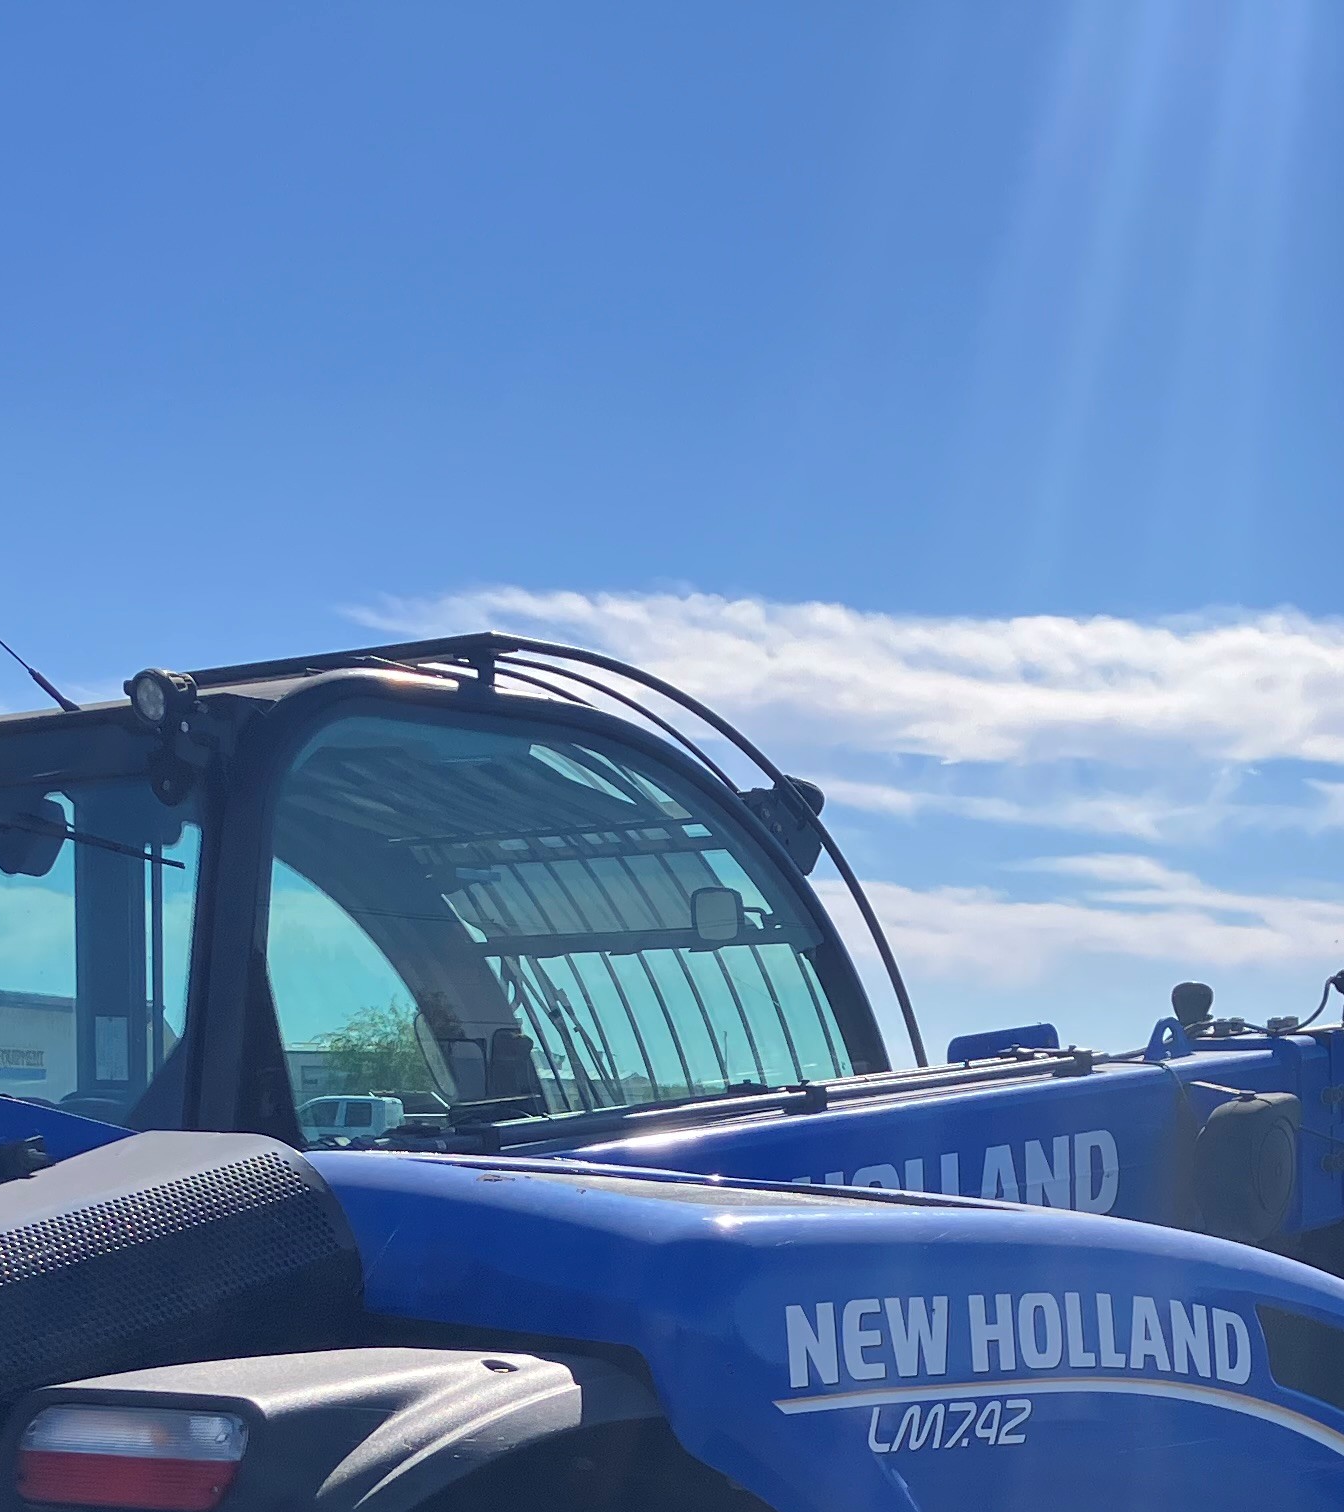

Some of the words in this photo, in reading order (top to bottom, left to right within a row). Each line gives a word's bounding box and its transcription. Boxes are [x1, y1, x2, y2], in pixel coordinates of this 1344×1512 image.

[791, 1129, 1119, 1214] LAND
[785, 1295, 949, 1388] NEW
[967, 1291, 1252, 1386] HOLLAND
[867, 1398, 1033, 1454] LM7.42
